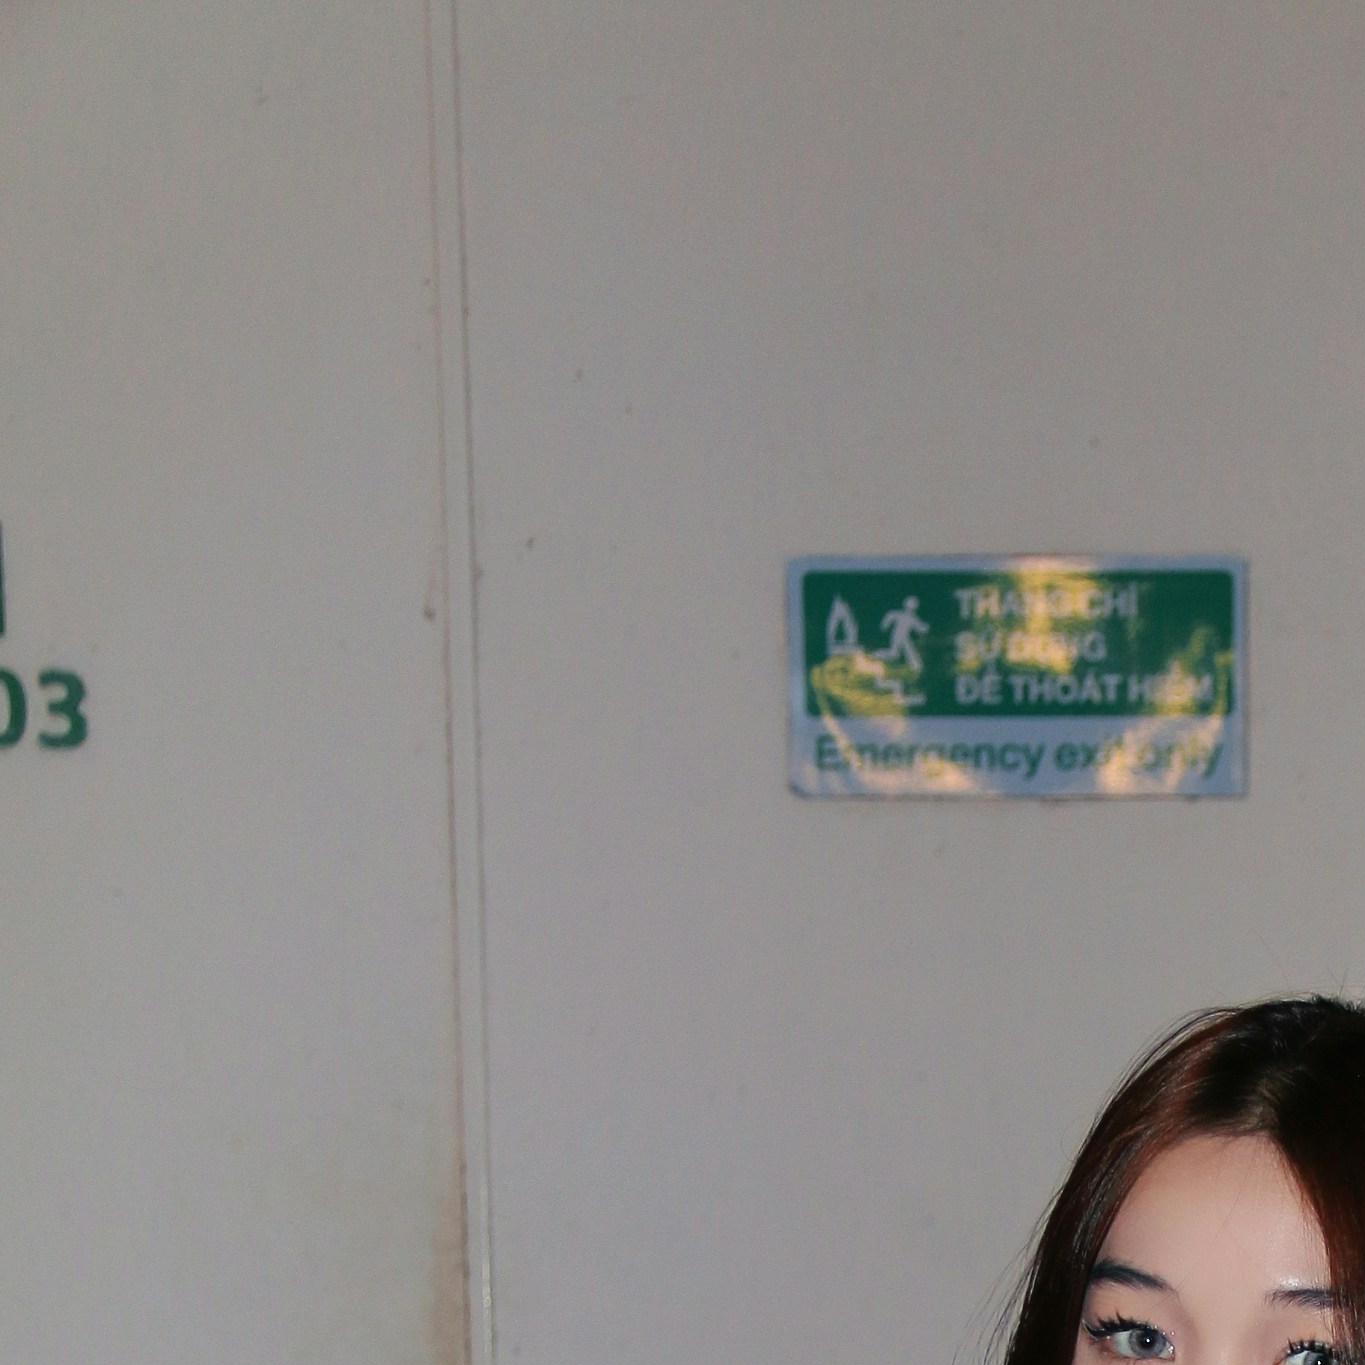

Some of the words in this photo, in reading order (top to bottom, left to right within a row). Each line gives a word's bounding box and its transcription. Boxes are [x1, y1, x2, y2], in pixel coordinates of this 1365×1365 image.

[954, 588, 1073, 618] THANG
[1008, 667, 1122, 704] THOÁT
[815, 734, 1046, 779] Emergency
[1055, 736, 1126, 771] exit
[1136, 735, 1223, 779] only
